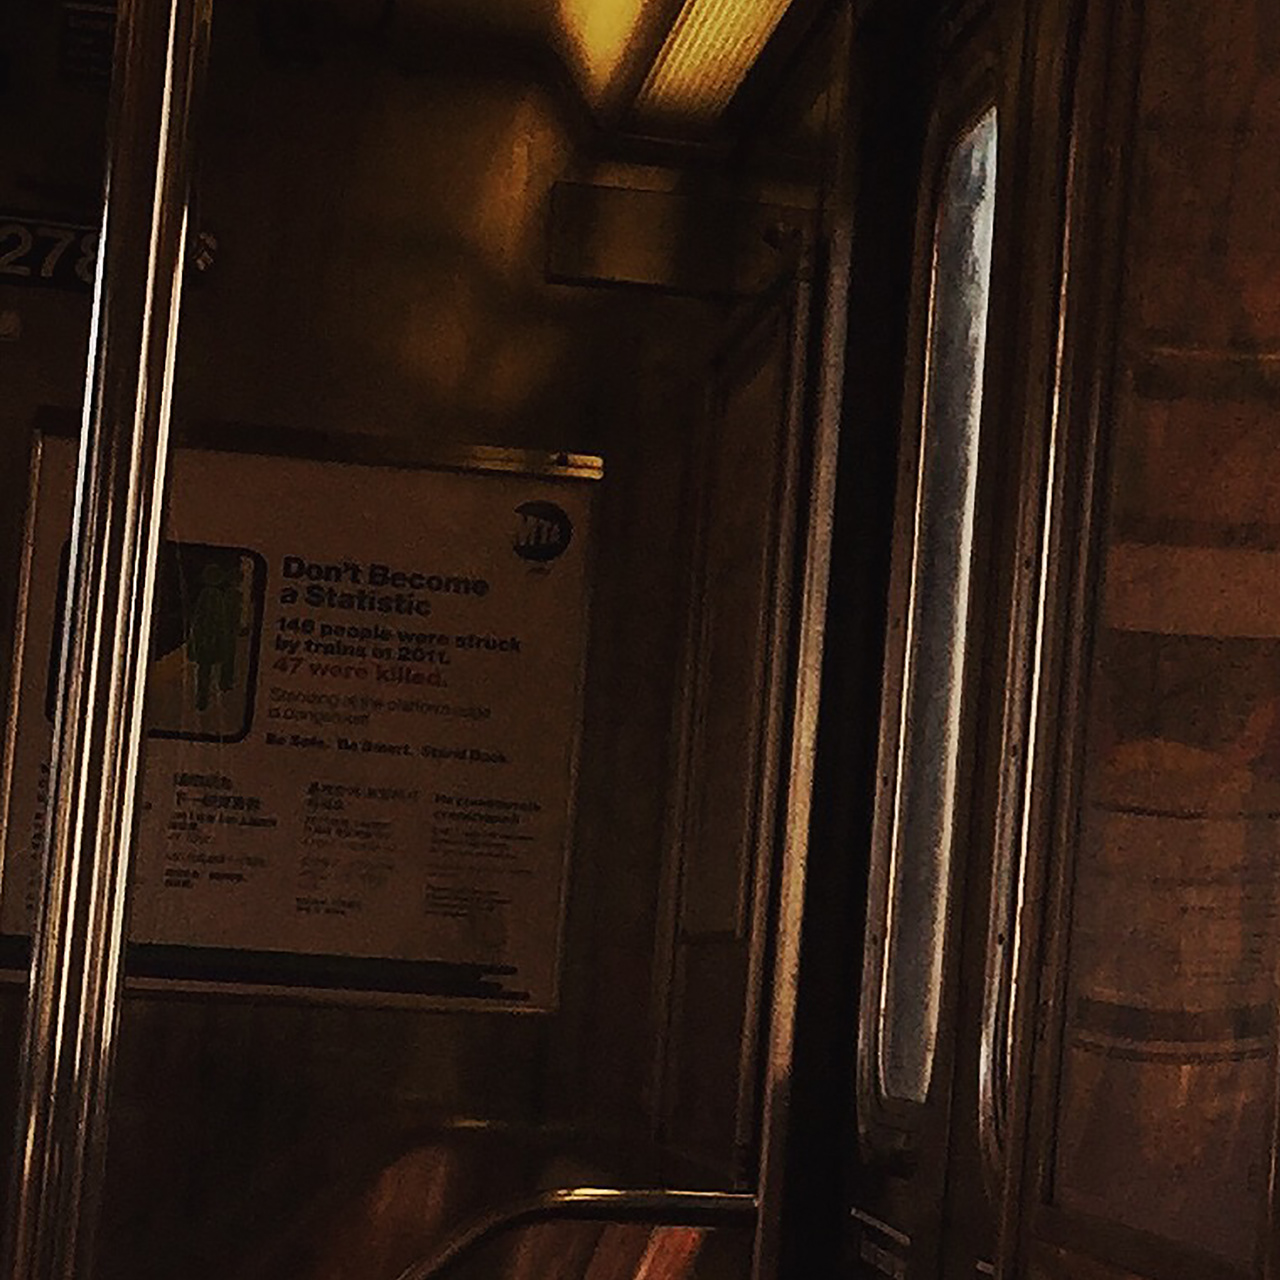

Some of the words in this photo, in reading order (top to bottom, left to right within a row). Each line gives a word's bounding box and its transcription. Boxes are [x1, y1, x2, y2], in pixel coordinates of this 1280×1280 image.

[282, 556, 362, 585] Don't
[368, 563, 490, 597] Become
[279, 587, 298, 604] a
[304, 584, 432, 616] Statistic
[275, 635, 301, 654] by
[304, 638, 367, 658] trains
[320, 623, 393, 642] people
[397, 630, 450, 646] were
[455, 634, 521, 653] struck
